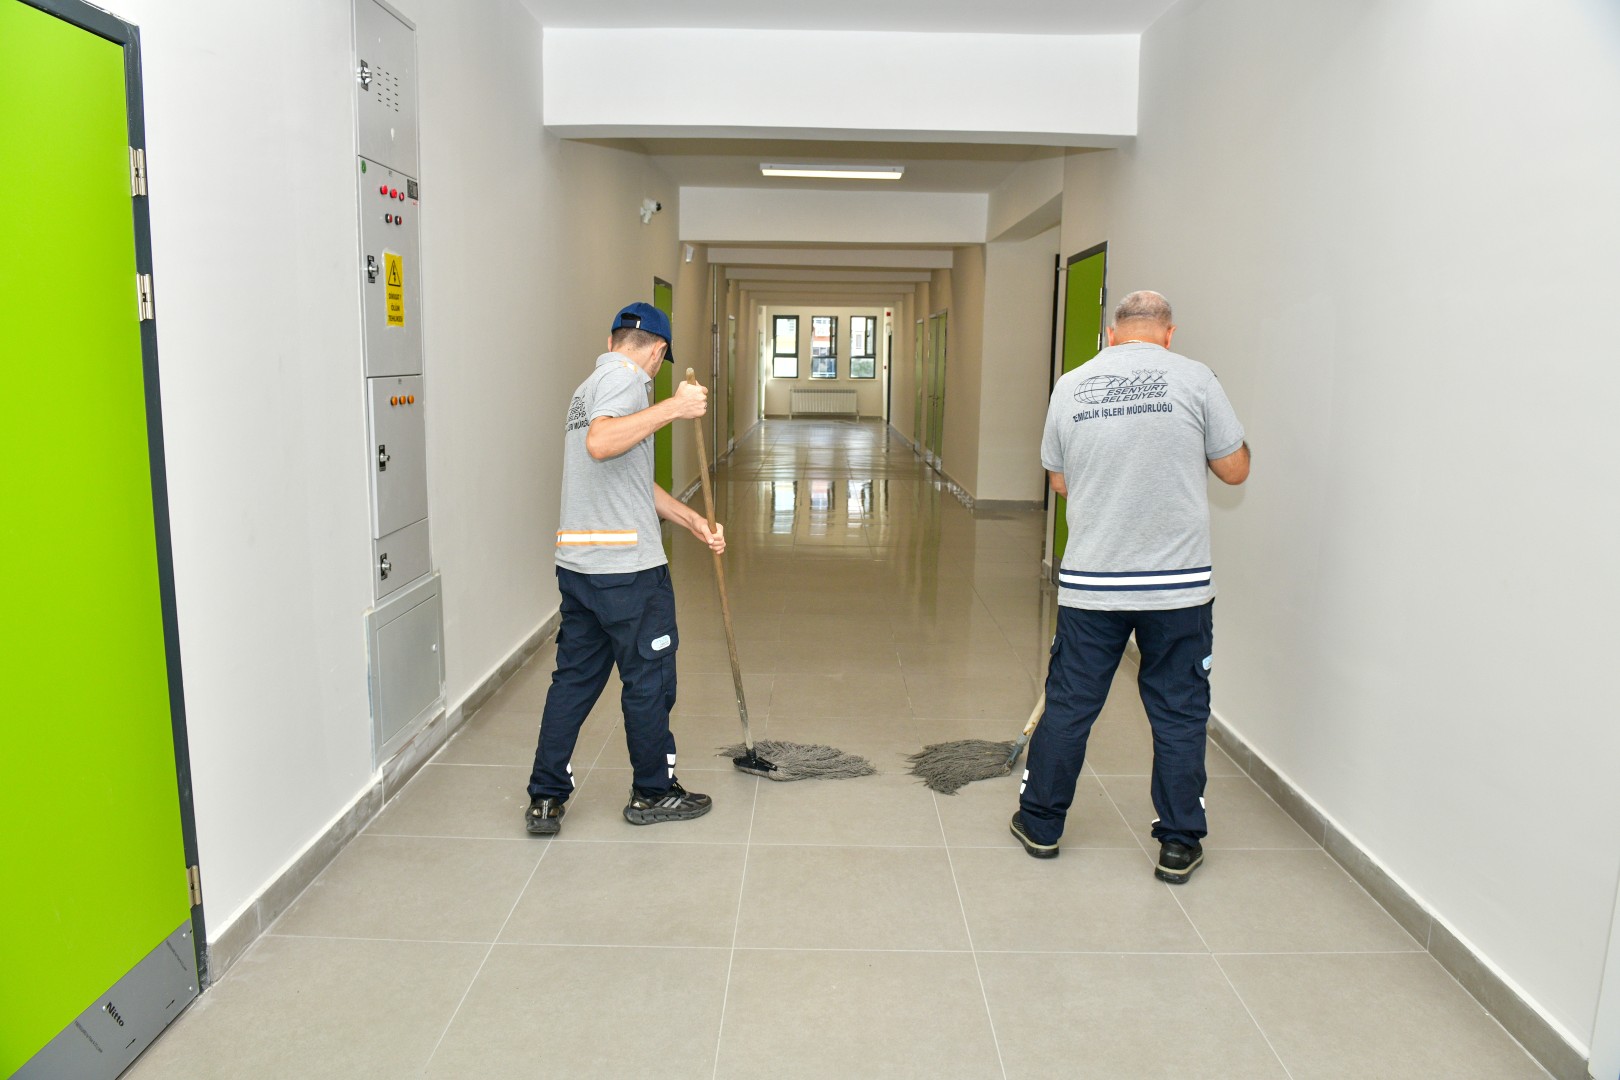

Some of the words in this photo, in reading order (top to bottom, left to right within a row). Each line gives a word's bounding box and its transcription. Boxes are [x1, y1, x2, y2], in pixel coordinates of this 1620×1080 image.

[1101, 390, 1167, 403] BELEDİYESİ
[1106, 385, 1168, 396] ESENYURT
[1101, 405, 1124, 419] İŞLERİ
[1126, 402, 1172, 415] MÜDÜRLÜĞÜ
[106, 1002, 124, 1026] Nitto
